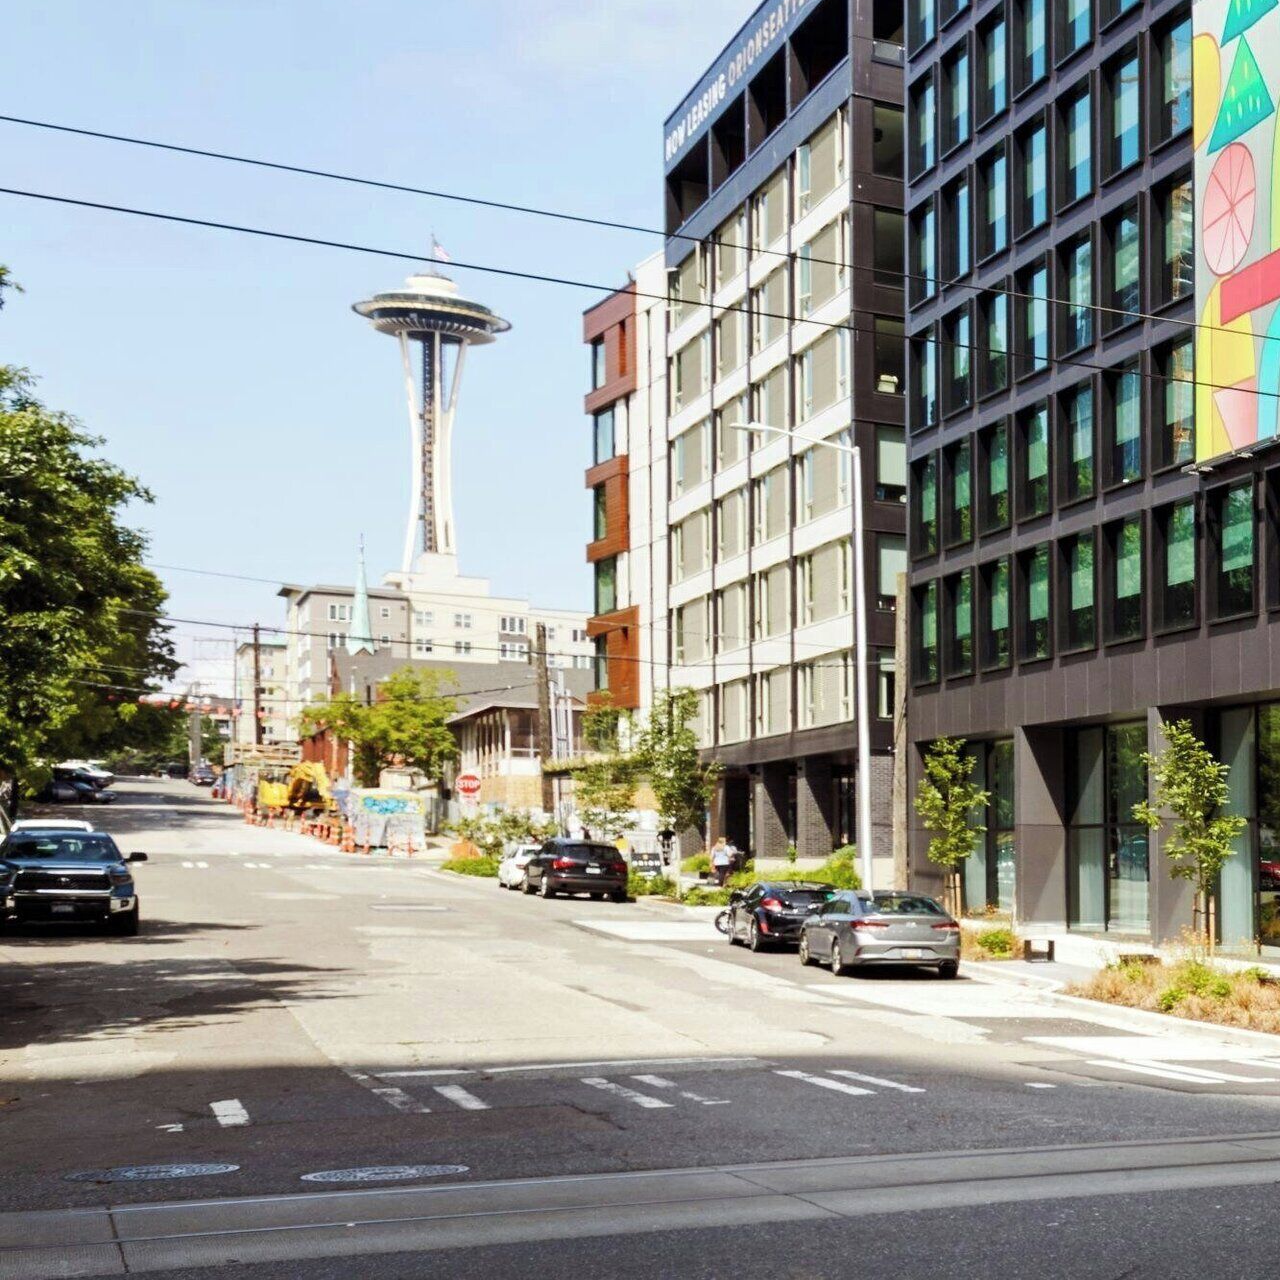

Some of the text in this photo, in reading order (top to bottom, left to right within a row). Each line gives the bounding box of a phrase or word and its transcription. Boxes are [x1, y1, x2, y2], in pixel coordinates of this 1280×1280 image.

[665, 119, 686, 162] NOW
[687, 73, 726, 137] LEASING
[455, 780, 480, 788] STOP
